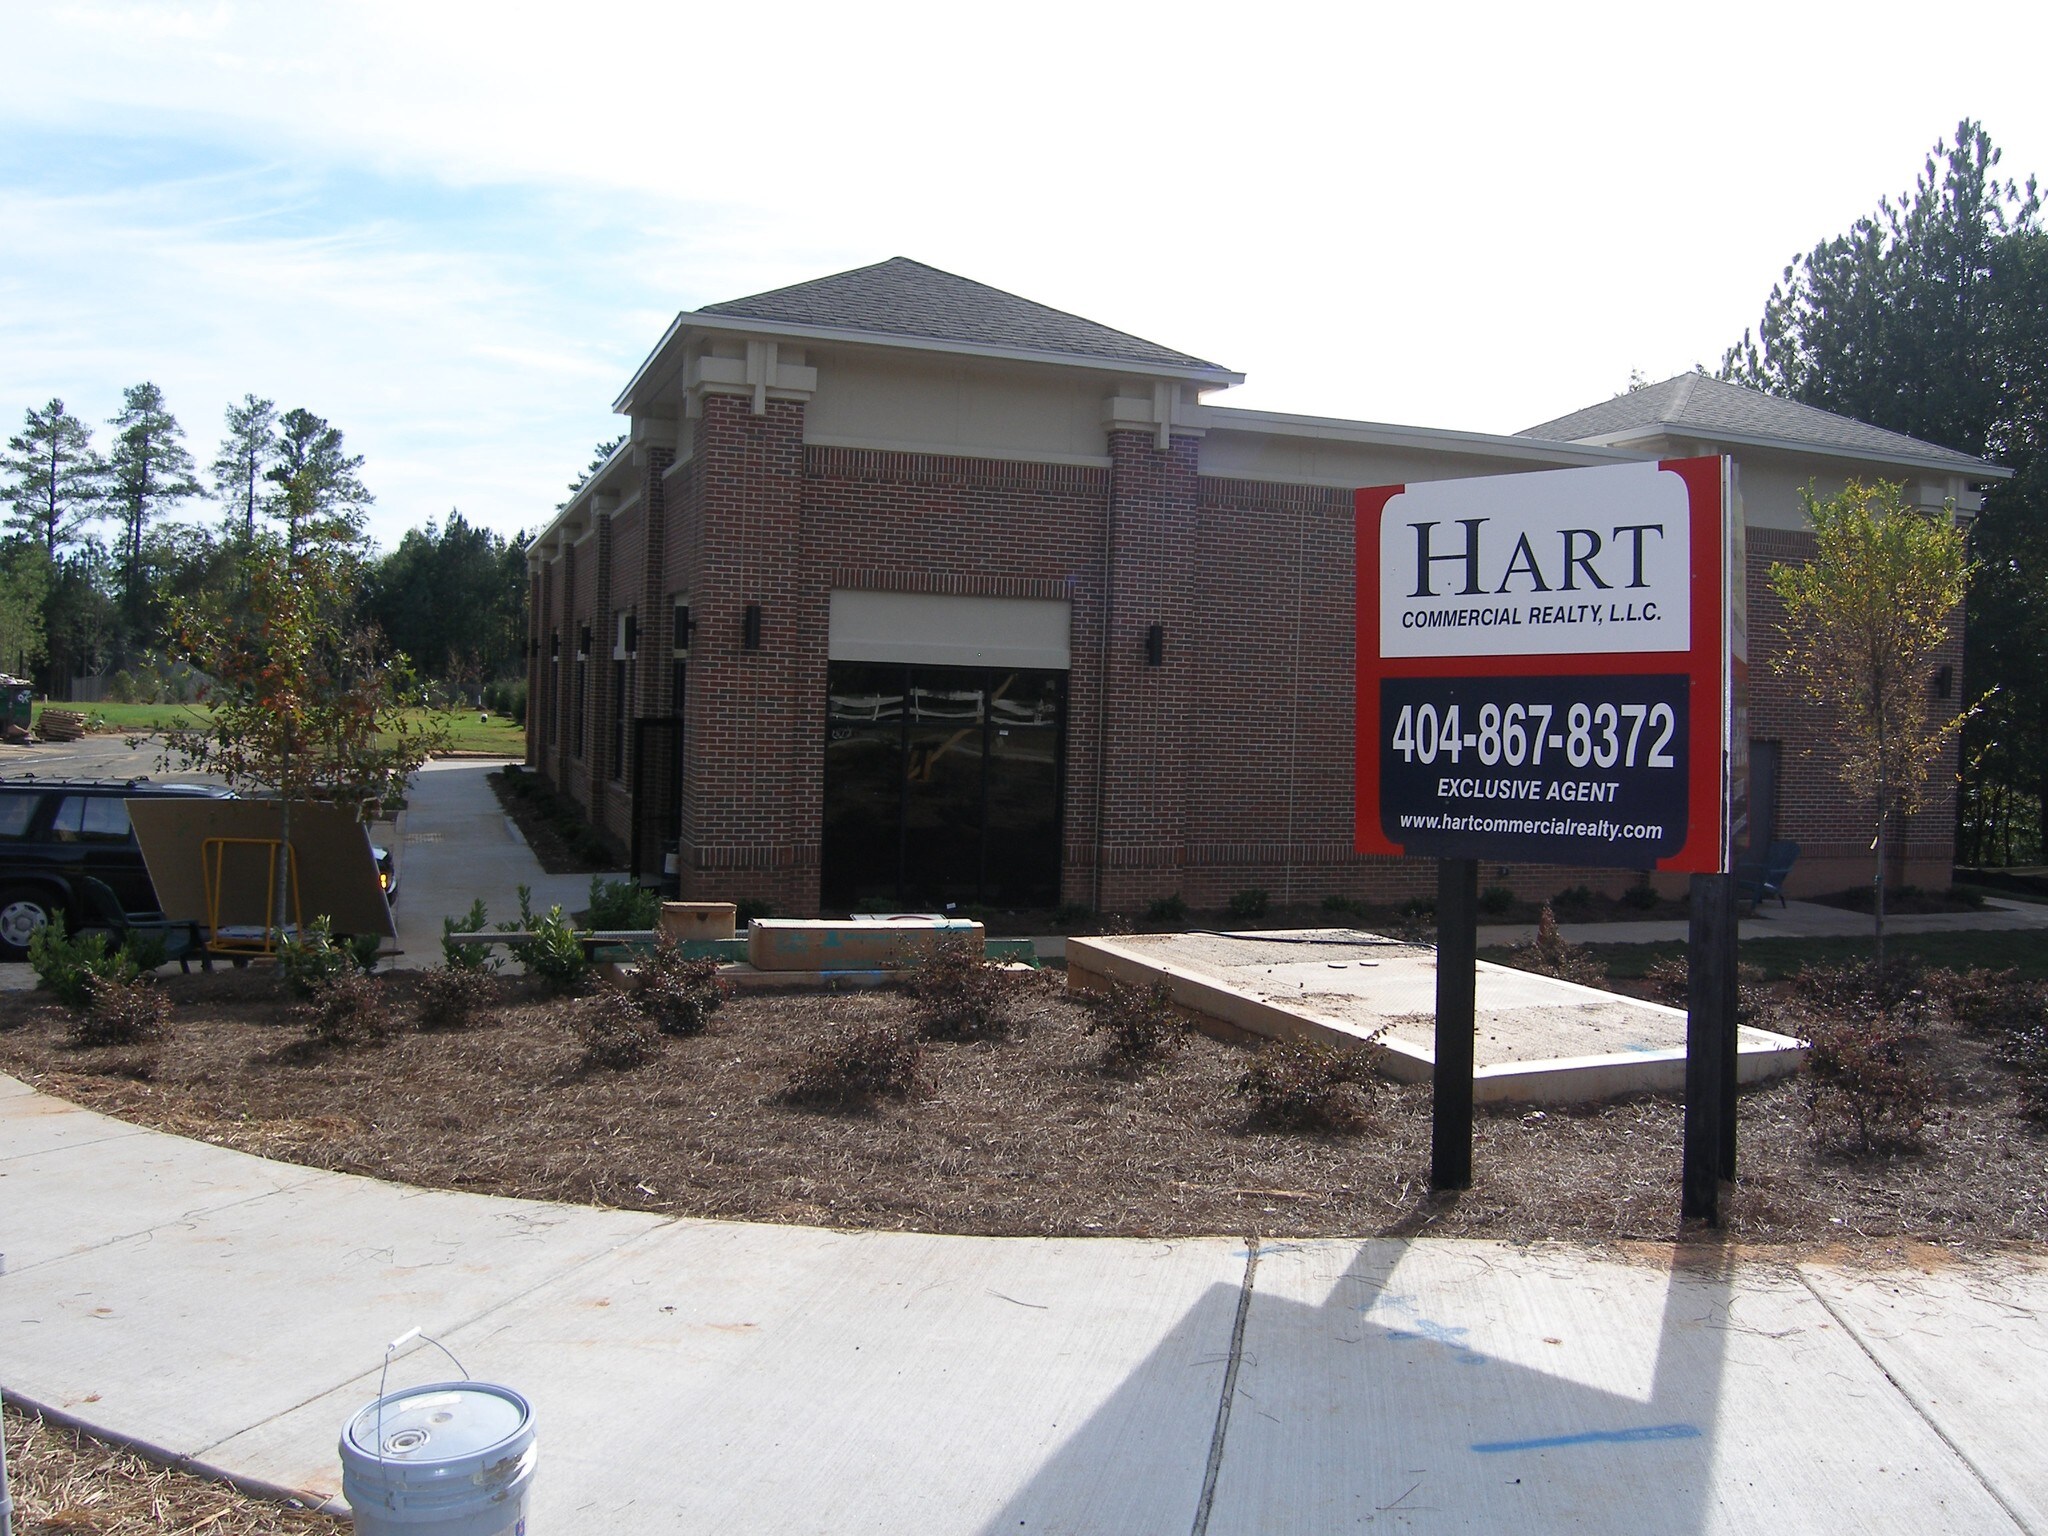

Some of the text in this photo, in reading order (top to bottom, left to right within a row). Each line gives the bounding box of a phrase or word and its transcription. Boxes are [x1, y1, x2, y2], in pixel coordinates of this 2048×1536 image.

[1406, 517, 1664, 598] HART
[1402, 602, 1662, 628] COMMERCIAL REALTY, L.L.C.
[1392, 702, 1675, 768] 404-867-8372
[1437, 778, 1619, 802] EXCLUSIVE AGENT
[1400, 813, 1662, 841] www.hartcommercialrealty.com
